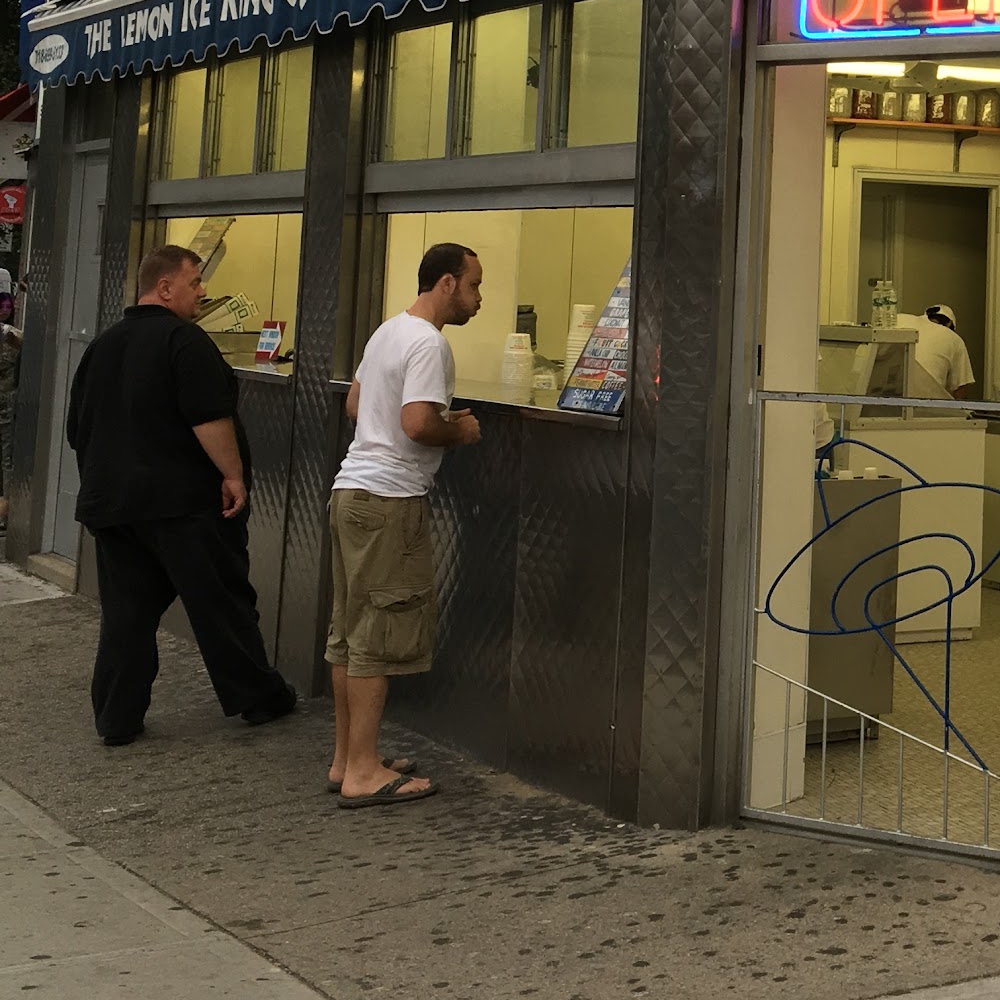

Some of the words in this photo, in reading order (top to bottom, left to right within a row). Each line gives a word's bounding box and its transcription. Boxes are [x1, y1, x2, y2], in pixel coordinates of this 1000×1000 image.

[84, 18, 112, 60] THE
[121, 1, 172, 47] LEMON
[573, 388, 594, 400] SUGAR
[595, 391, 613, 402] FREE
